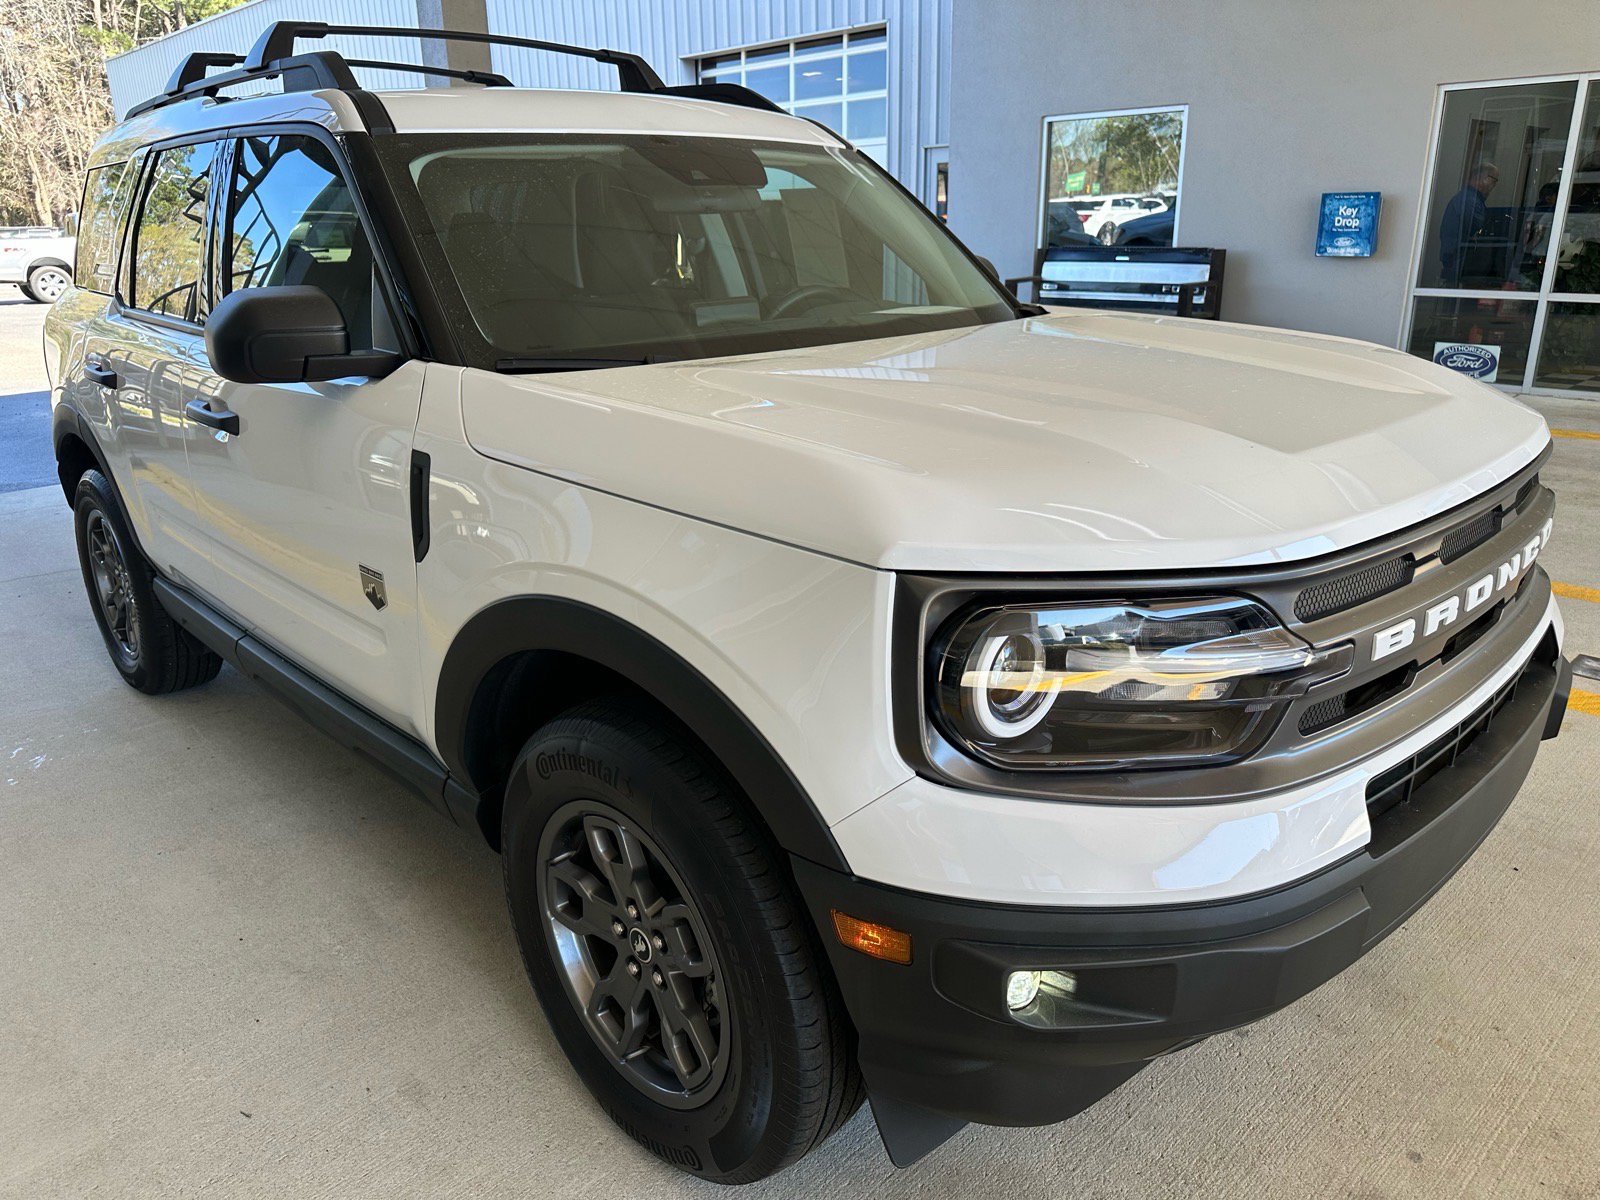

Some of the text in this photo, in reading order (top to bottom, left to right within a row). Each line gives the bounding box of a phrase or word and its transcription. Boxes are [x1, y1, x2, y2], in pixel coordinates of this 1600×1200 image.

[1339, 205, 1359, 218] Key
[1334, 216, 1360, 228] Drop
[1162, 285, 1200, 294] FOD
[1443, 346, 1492, 359] AUTHORIZED
[1447, 354, 1484, 368] Ford
[536, 746, 620, 790] Continental
